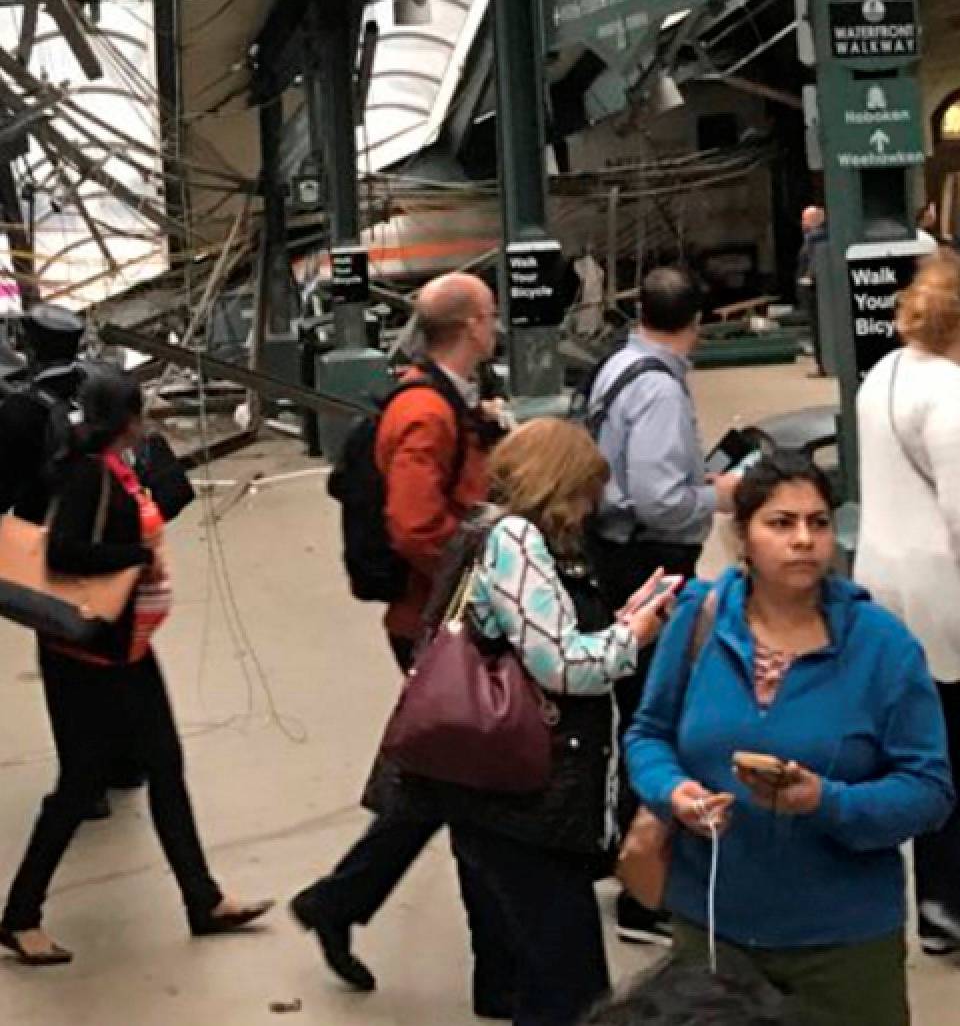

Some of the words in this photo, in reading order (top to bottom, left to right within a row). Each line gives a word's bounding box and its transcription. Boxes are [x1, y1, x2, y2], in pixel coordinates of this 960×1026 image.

[834, 25, 914, 38] WATERFRONT
[836, 40, 916, 54] WALKWAY
[845, 110, 909, 124] Hoboken
[851, 266, 897, 286] Walk
[855, 318, 894, 338] Bicy
